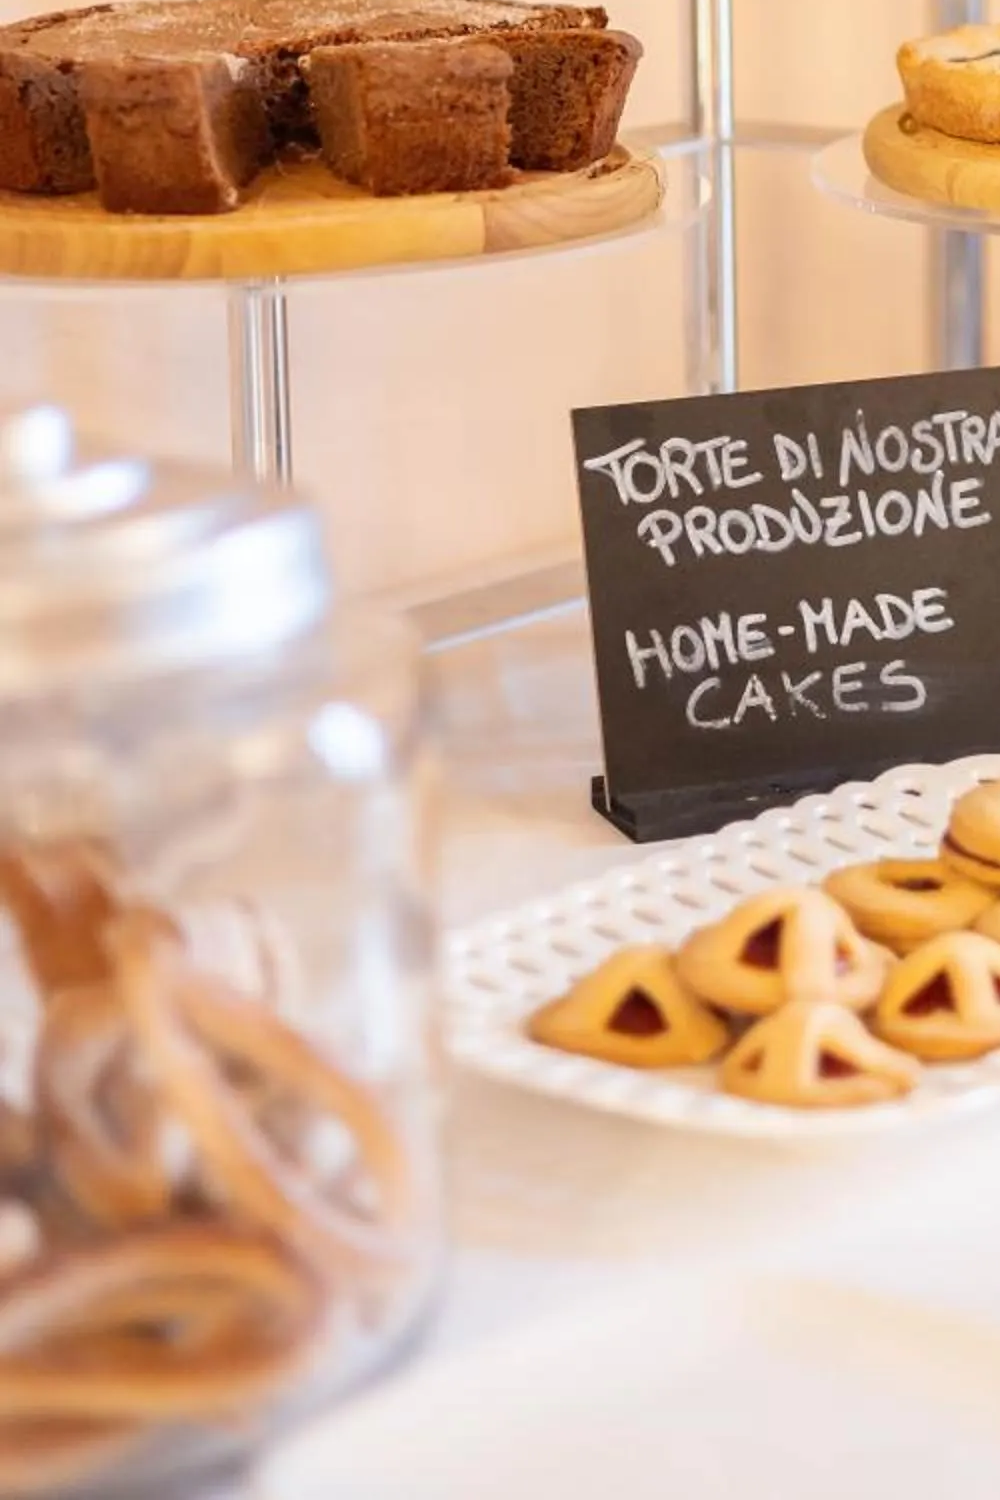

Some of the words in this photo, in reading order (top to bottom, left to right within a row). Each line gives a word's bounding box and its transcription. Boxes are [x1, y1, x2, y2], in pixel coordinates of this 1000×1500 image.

[583, 436, 763, 506] TORTE
[773, 432, 823, 482] DI
[637, 469, 991, 567] PRODUZIONE
[625, 587, 954, 689] HOME-MADE
[685, 660, 928, 729] CAKES
